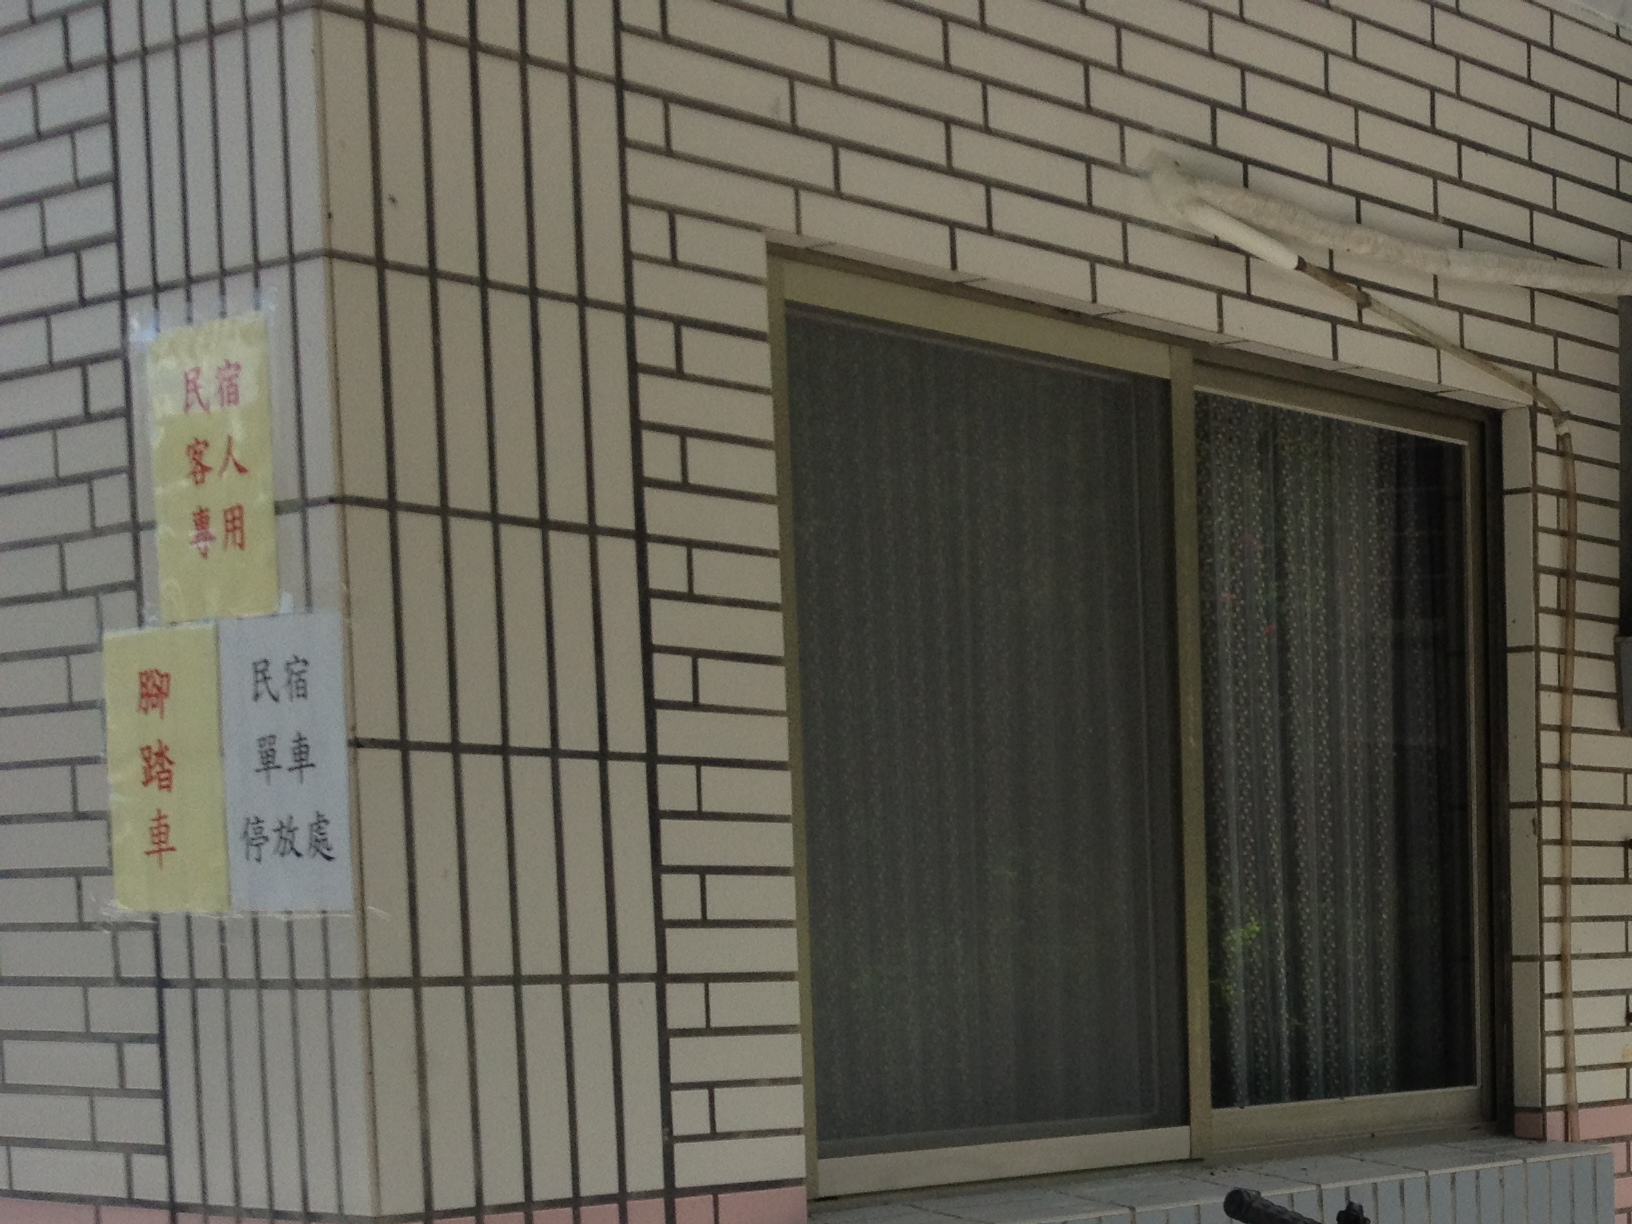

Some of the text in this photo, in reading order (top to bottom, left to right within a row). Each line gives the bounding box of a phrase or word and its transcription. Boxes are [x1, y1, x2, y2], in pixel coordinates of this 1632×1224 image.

[182, 360, 243, 414] 民宿
[184, 434, 249, 486] 客人
[188, 503, 247, 560] 專用
[251, 655, 310, 704] 民宿
[135, 668, 177, 871] 腳踏車
[254, 731, 316, 786] 單車
[240, 811, 337, 864] 停放處
